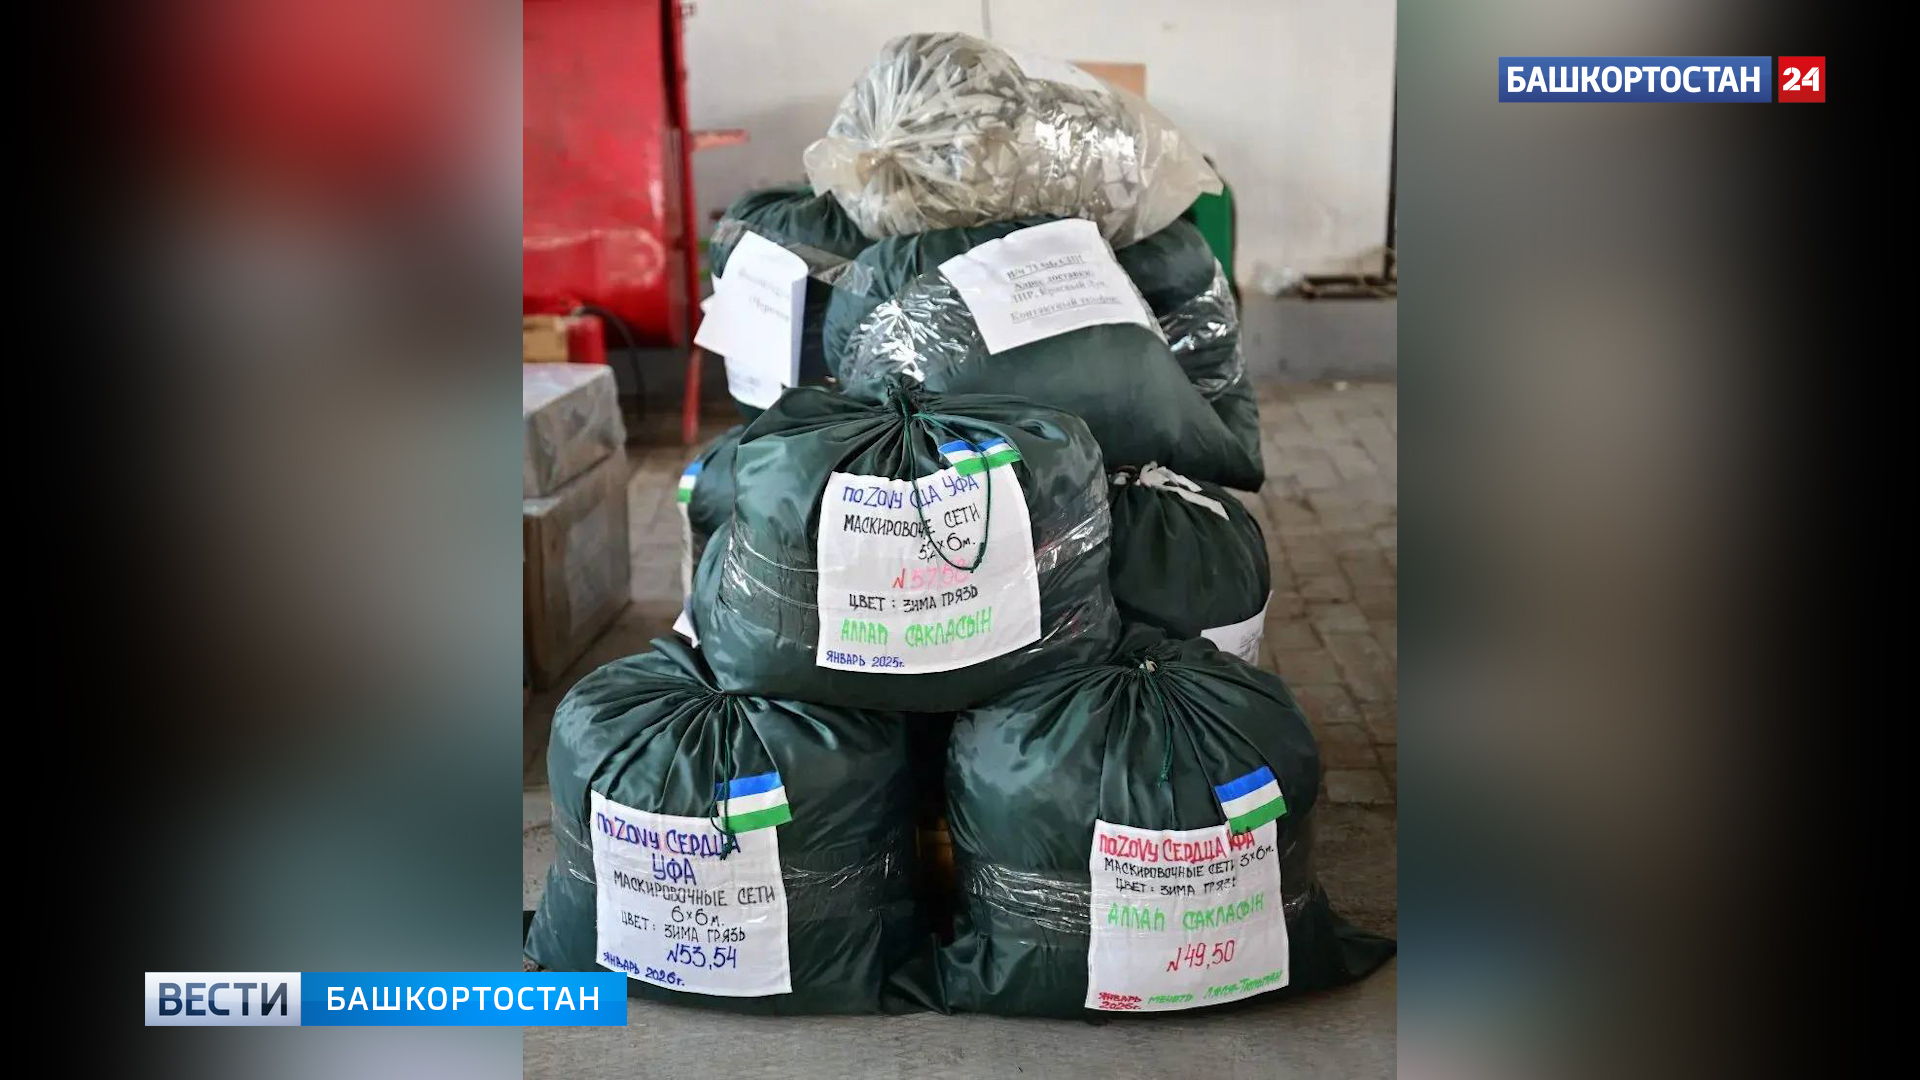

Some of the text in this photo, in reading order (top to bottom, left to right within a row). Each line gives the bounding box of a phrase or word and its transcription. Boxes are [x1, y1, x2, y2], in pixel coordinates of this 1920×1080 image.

[942, 474, 979, 498] УФА
[943, 503, 981, 529] СЕТИ
[902, 595, 937, 613] ЗИМА
[941, 584, 978, 607] ГРЯЗЬ
[826, 650, 866, 667] ЯНВАРЬ
[1162, 835, 1228, 864] СЕРДЦА
[652, 852, 697, 886] УФА
[1104, 857, 1205, 878] МАСКИРОВОЧНЫЕ
[613, 869, 776, 906] МАСКИРОВОЧНЫЕ СЕТИ
[1160, 885, 1196, 897] ЗИМА
[664, 923, 700, 943] ЗИМА
[707, 926, 747, 943] ГРЯЗЬ
[602, 951, 641, 975] ЯНВАРЬ
